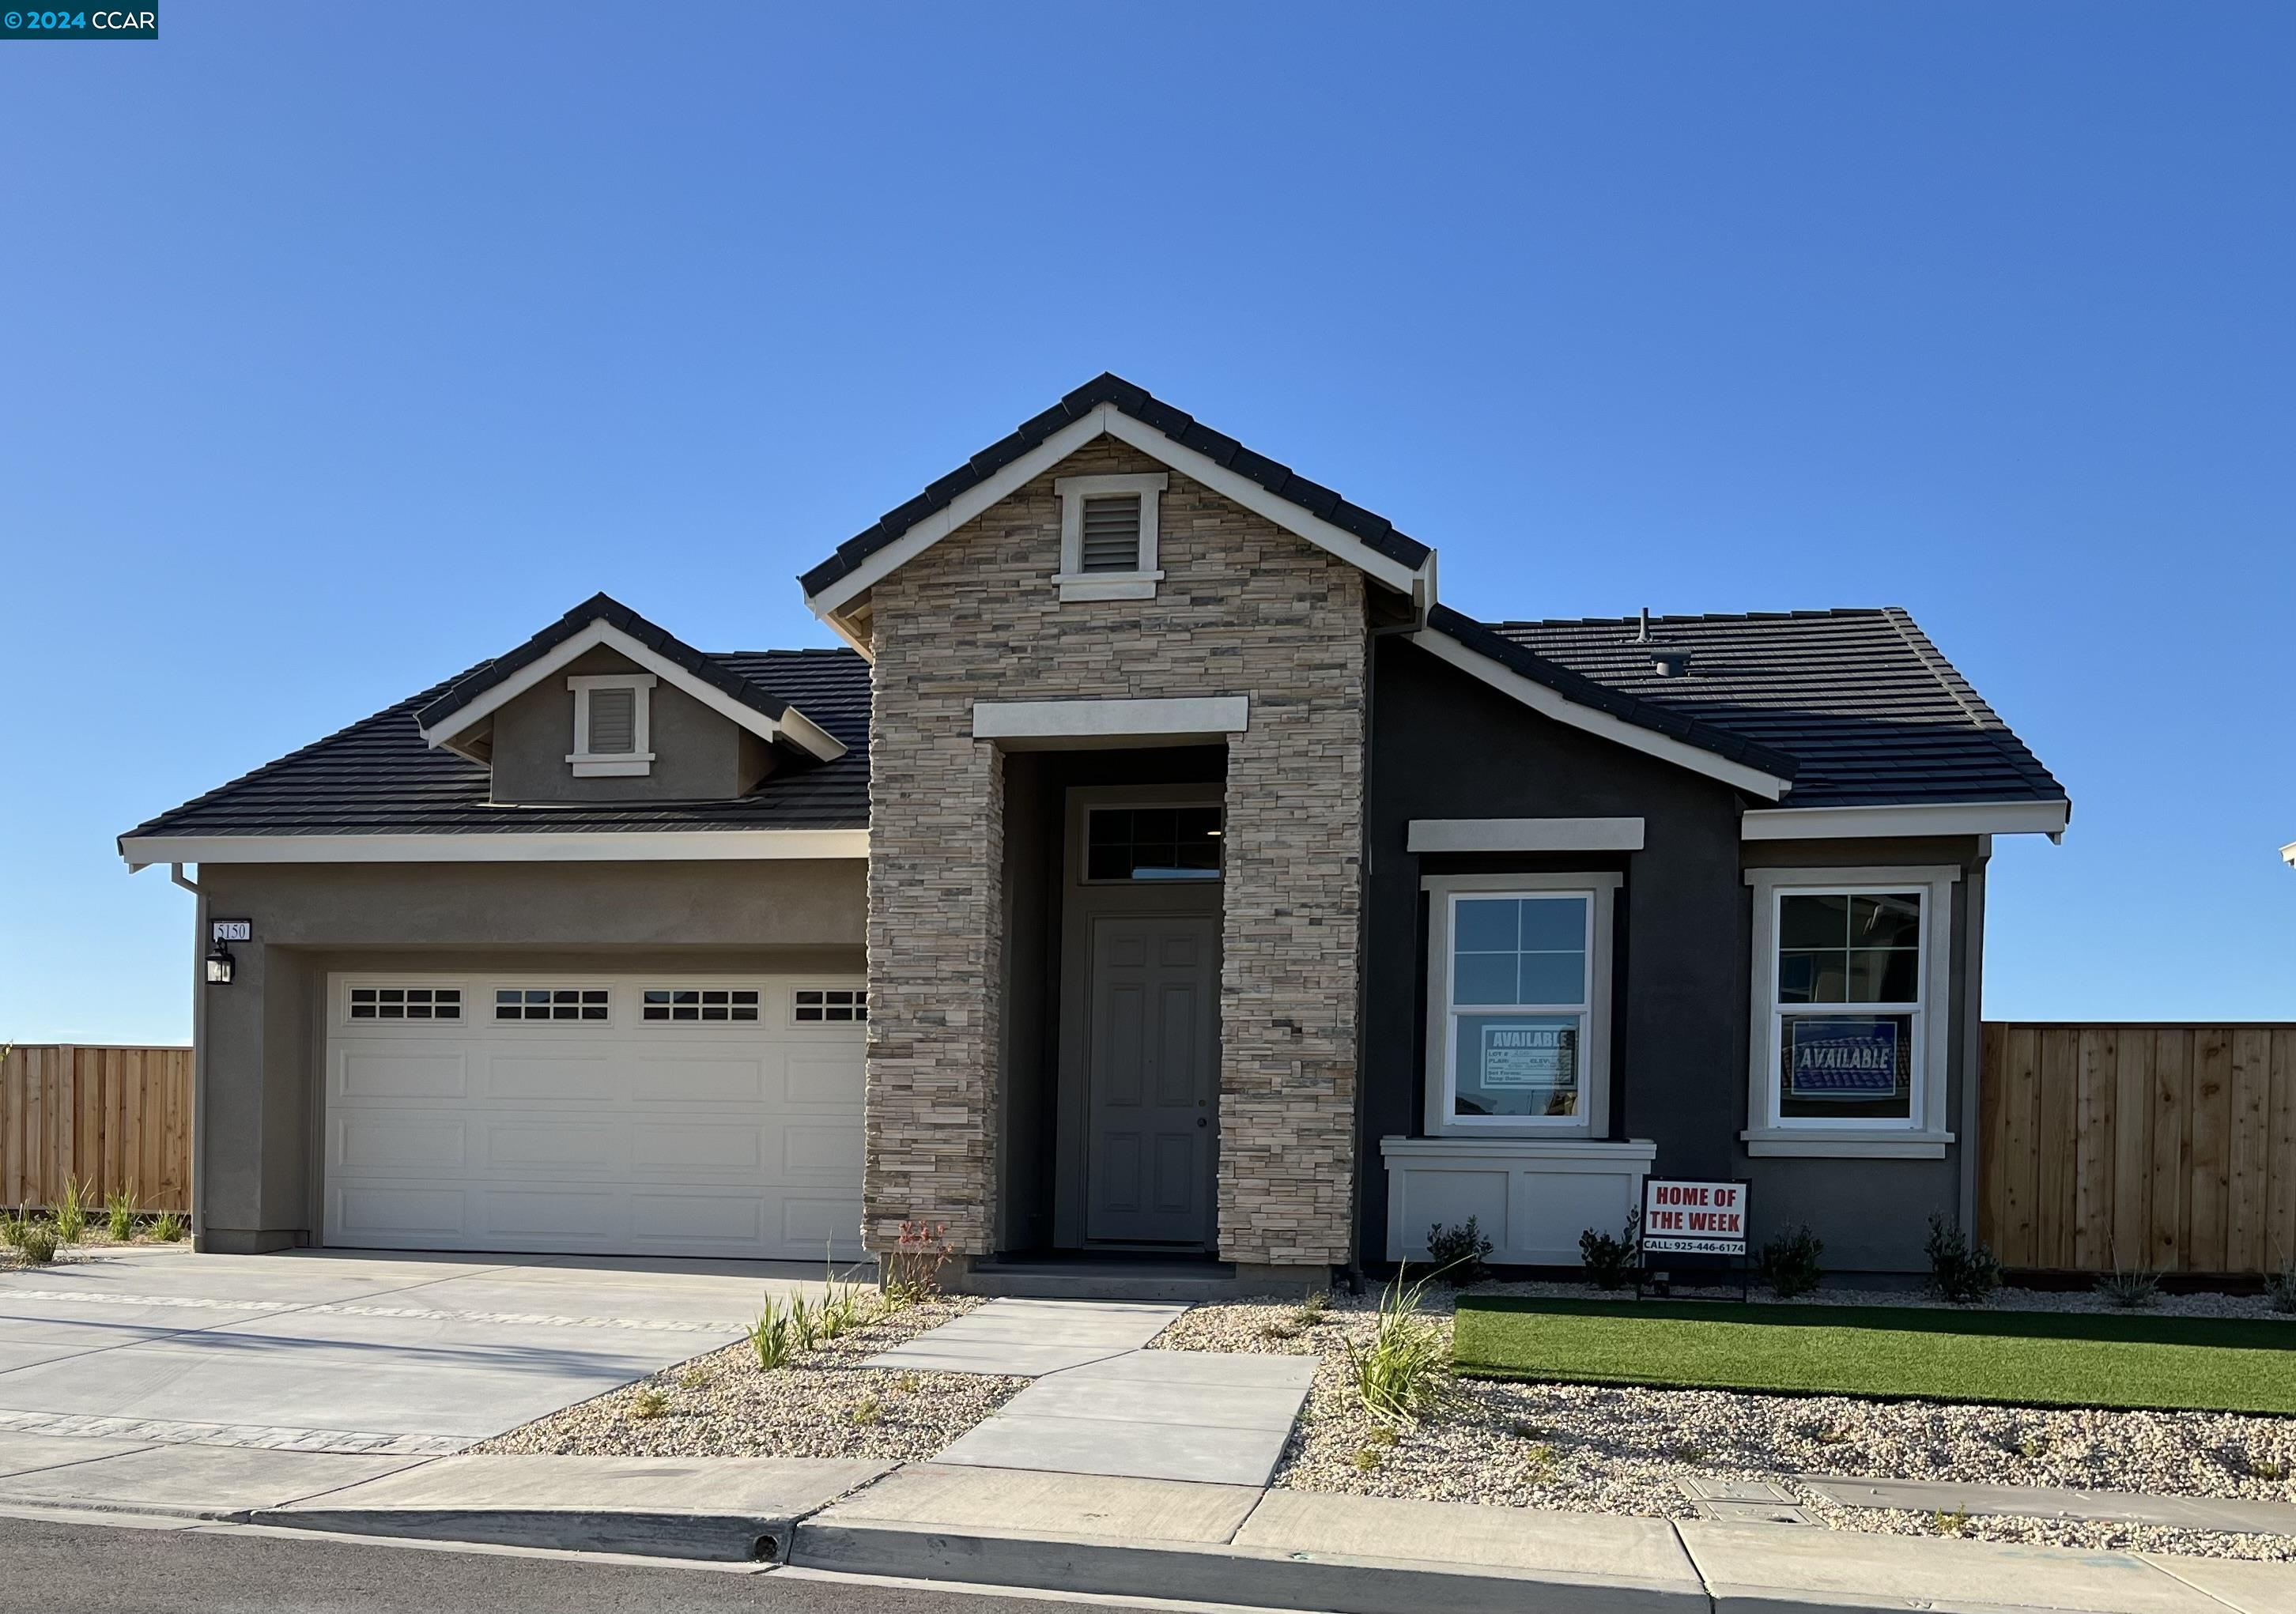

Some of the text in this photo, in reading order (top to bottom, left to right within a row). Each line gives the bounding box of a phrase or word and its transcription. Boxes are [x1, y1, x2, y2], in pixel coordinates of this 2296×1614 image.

[217, 925, 245, 939] 5150
[1493, 1031, 1568, 1047] AVAILABLE
[1800, 1048, 1890, 1069] AVAILABLE
[1656, 1187, 1737, 1207] HOME OF
[1650, 1211, 1740, 1232] THE WEEK
[1644, 1240, 1743, 1252] CALL: 925-446-6174
